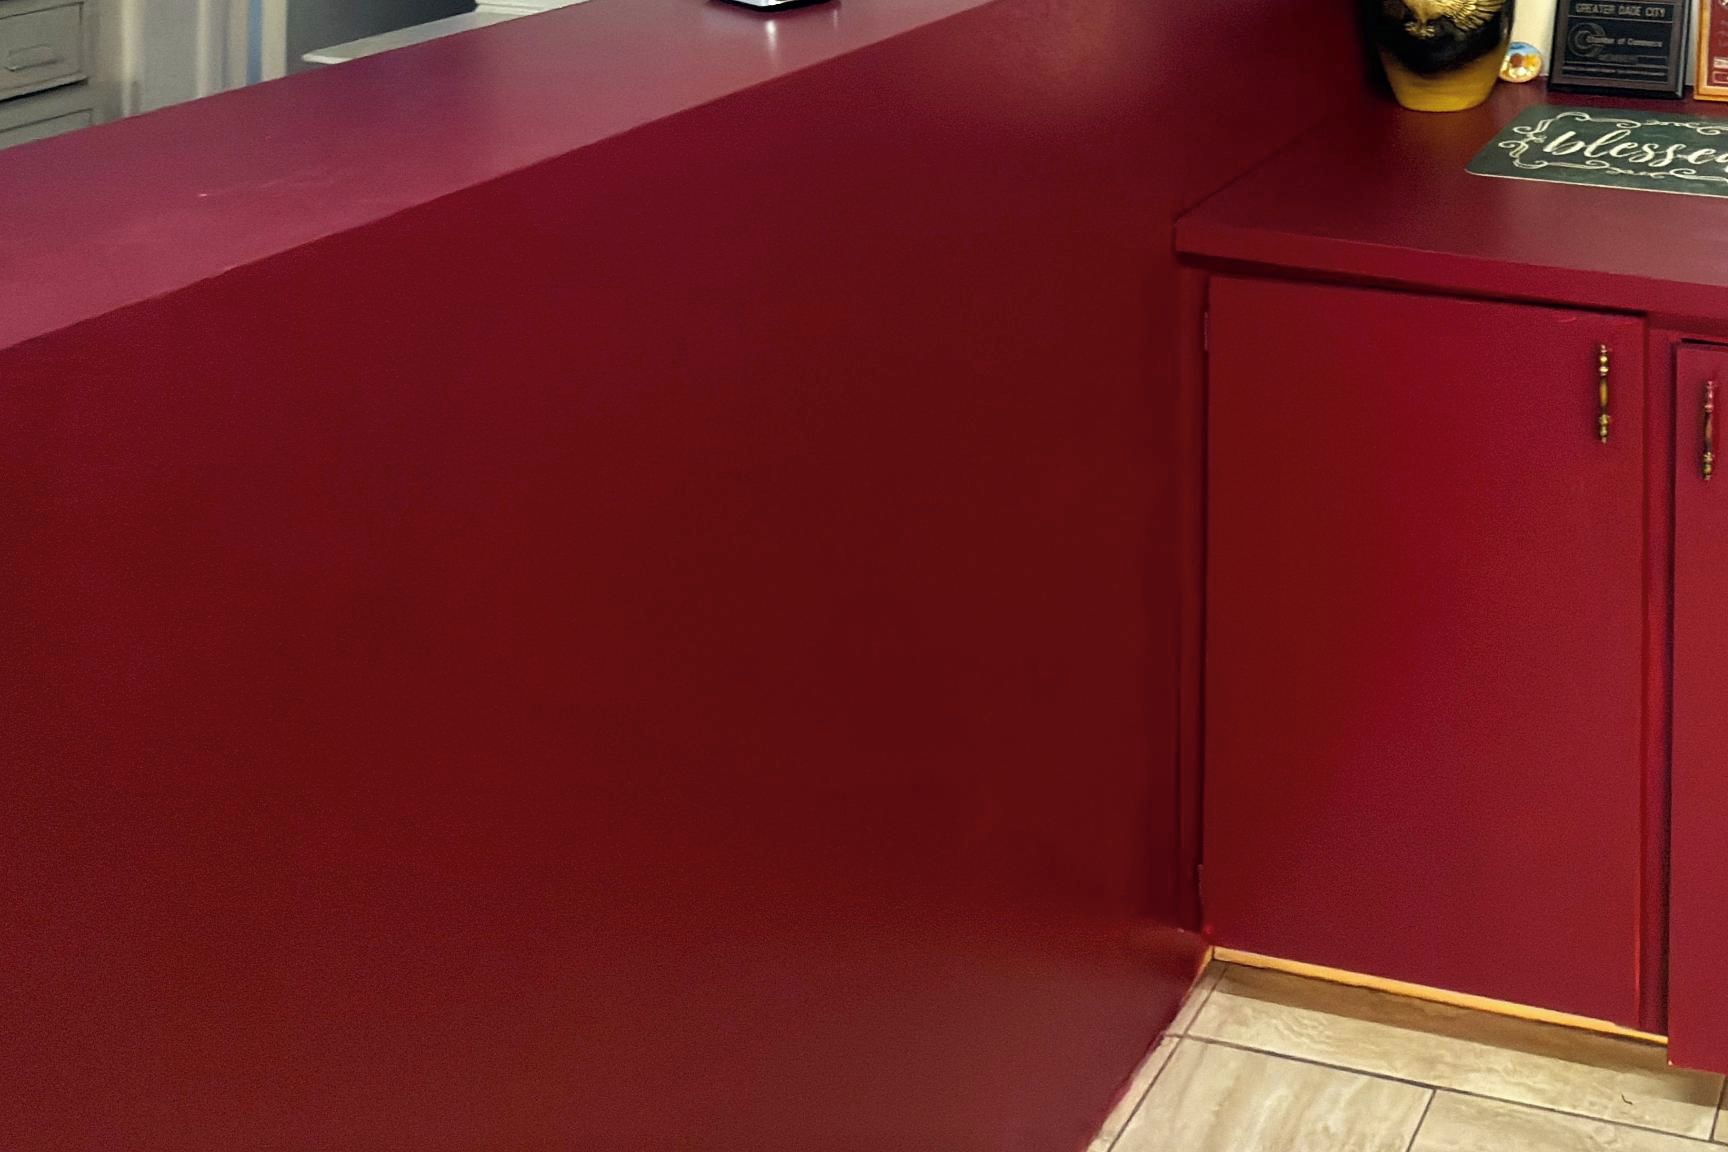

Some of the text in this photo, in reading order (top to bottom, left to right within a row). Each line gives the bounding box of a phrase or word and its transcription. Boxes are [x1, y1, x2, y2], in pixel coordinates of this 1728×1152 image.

[1575, 3, 1666, 18] GREATER DADE CITY
